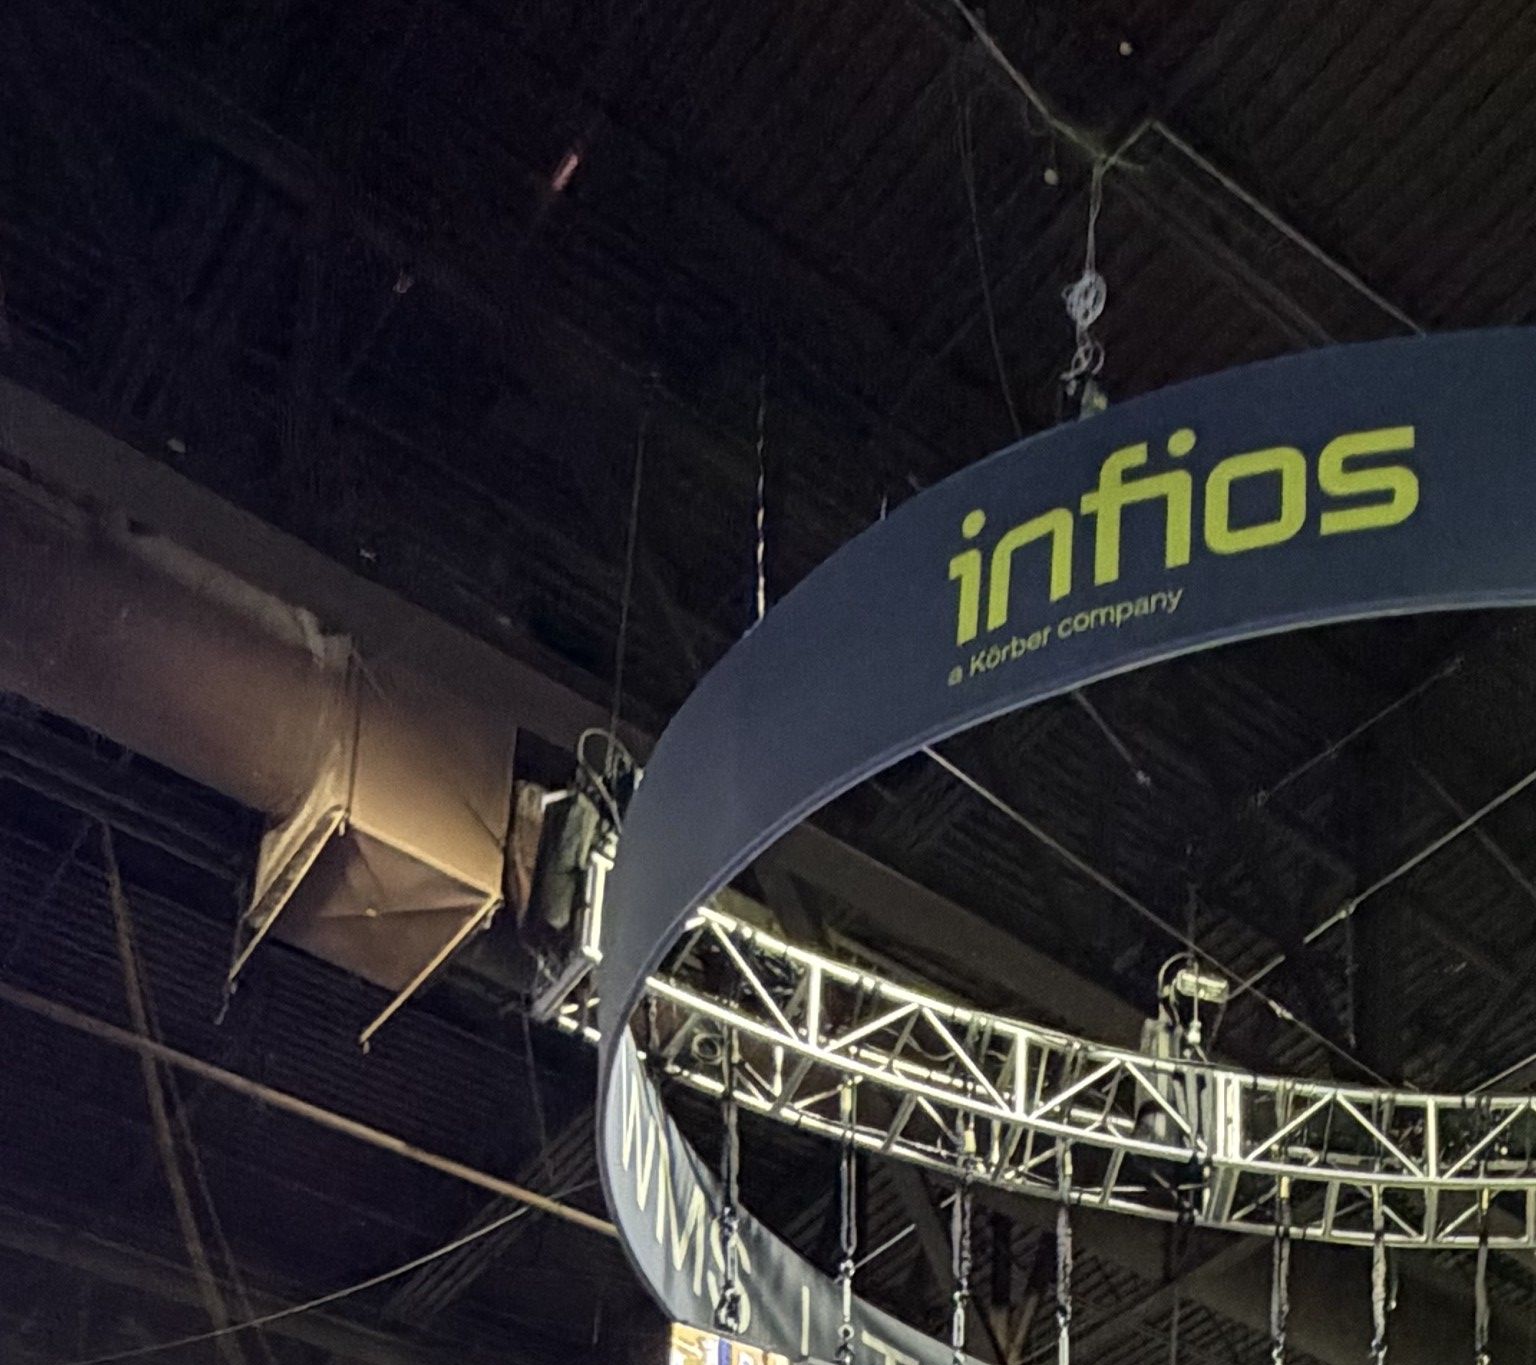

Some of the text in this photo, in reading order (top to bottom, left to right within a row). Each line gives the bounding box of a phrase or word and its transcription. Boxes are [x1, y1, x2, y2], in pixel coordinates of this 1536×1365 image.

[949, 425, 1419, 646] infios
[948, 588, 1183, 687] a Körber company
